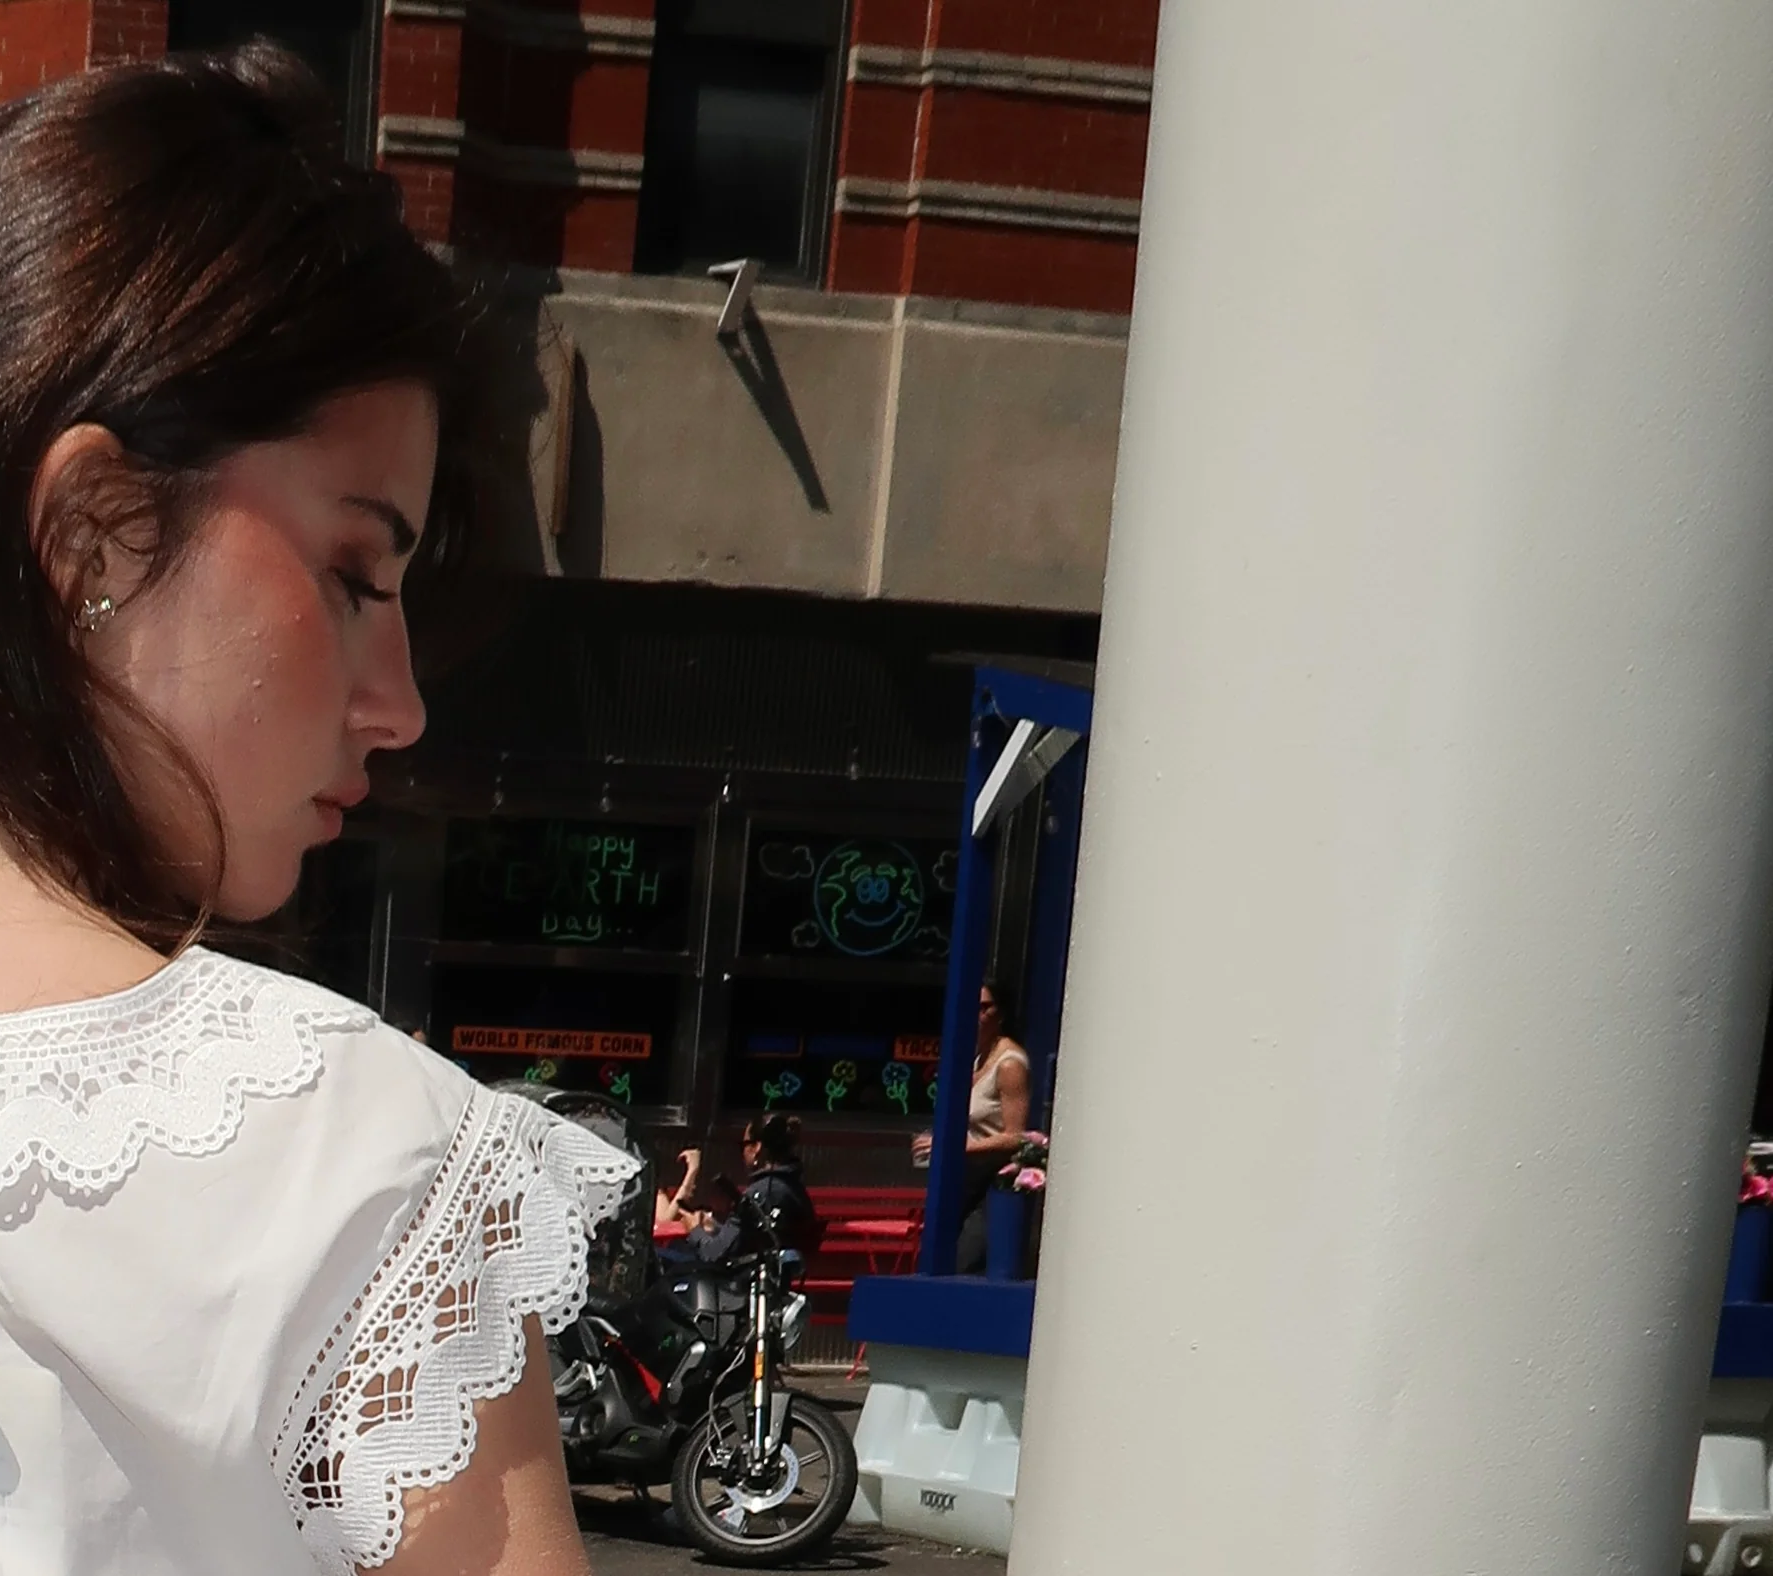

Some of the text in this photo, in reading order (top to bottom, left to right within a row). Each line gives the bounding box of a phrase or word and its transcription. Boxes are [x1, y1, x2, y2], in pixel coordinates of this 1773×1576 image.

[544, 819, 636, 870] Happy
[504, 860, 661, 905] EARTH
[459, 1030, 646, 1054] WORLD FAMOUS CORN
